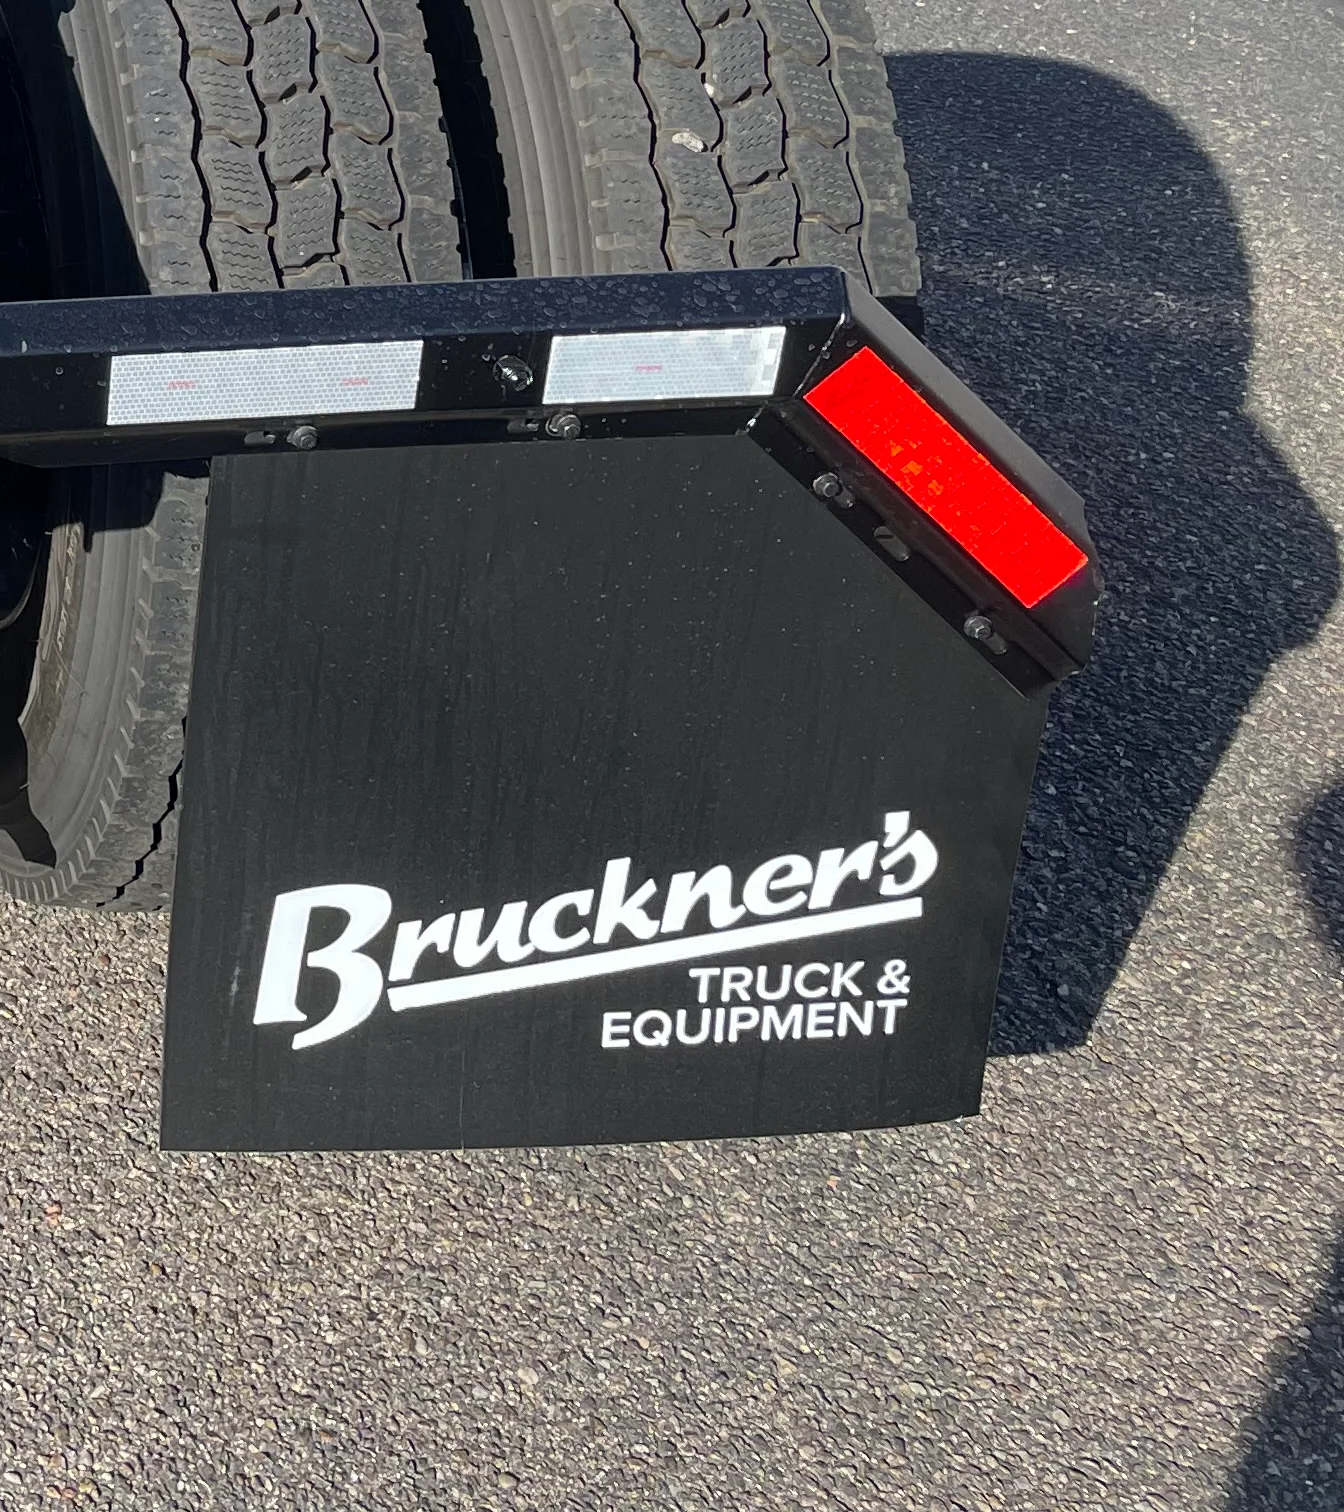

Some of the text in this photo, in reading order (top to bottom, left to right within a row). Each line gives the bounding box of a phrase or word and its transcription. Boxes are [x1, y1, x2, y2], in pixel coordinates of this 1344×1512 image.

[253, 810, 939, 1050] Bruckner's
[689, 959, 911, 1004] TRUCK &
[601, 998, 908, 1049] EQUIPMENT
